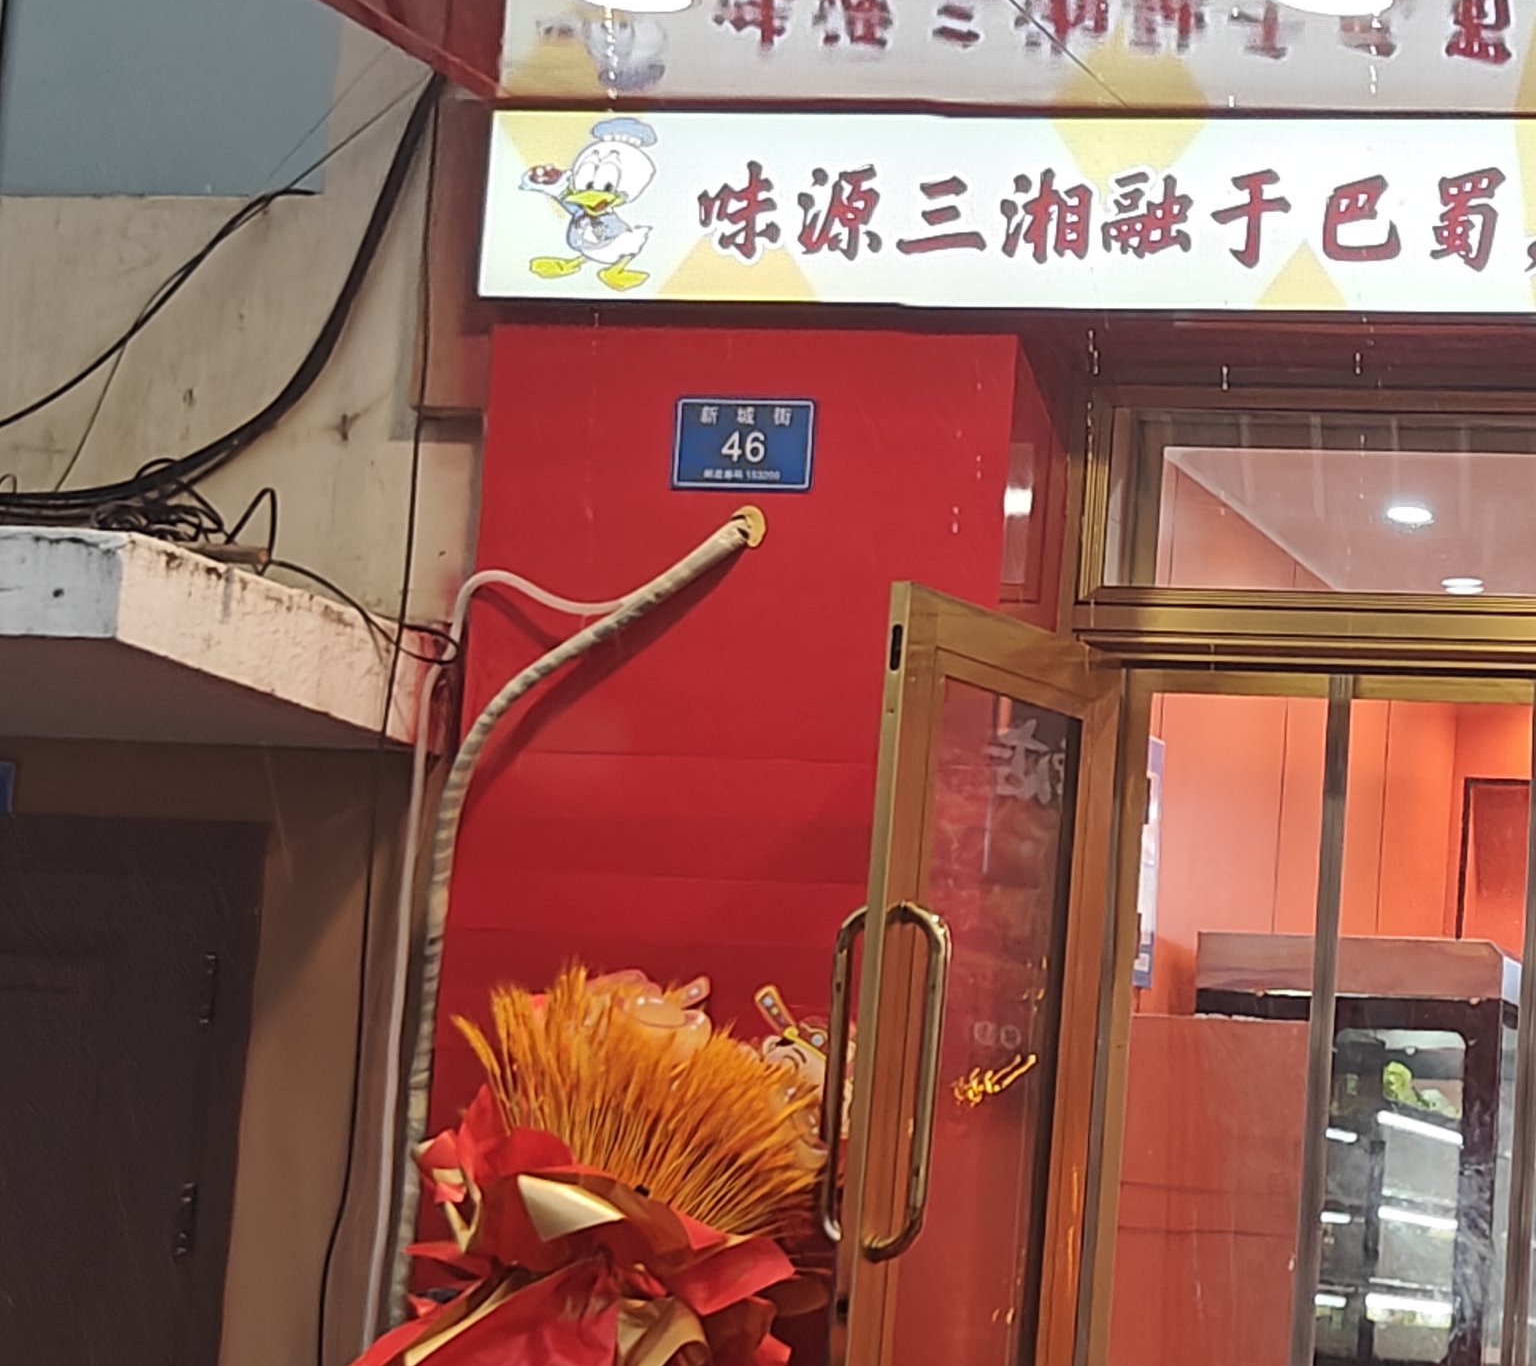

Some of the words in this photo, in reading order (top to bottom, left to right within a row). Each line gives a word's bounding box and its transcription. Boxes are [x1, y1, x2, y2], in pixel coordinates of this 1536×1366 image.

[700, 406, 792, 426] 新城街
[721, 430, 765, 463] 46
